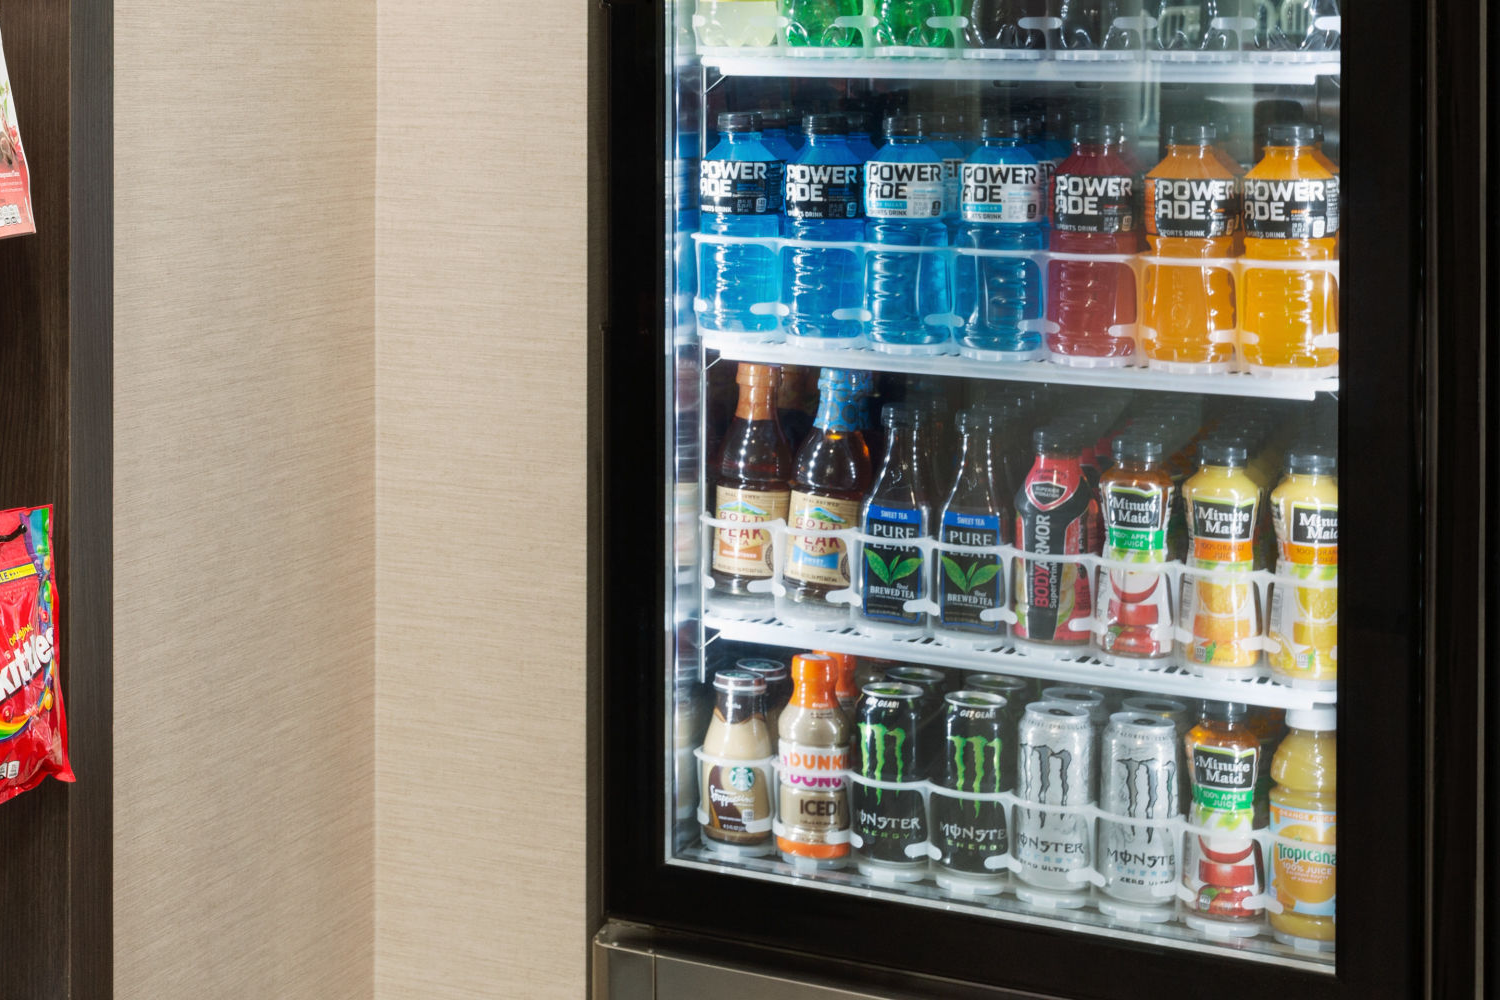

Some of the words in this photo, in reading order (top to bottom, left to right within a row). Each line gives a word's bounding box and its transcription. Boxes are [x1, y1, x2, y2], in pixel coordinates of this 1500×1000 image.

[701, 162, 766, 179] POWER
[786, 164, 857, 184] POWER
[869, 164, 942, 182] POWER
[963, 167, 1037, 185] POWER
[963, 185, 1001, 202] ADE
[1055, 176, 1133, 197] POWER
[1158, 180, 1235, 200] POWER
[1244, 180, 1324, 201] POWER
[1055, 197, 1098, 215] ADE
[1157, 201, 1208, 220] ADE
[1244, 202, 1287, 220] ADE
[1113, 497, 1156, 510] Minute
[881, 510, 896, 519] SWEET
[897, 511, 908, 519] TEA
[957, 516, 972, 525] SWEET
[973, 518, 985, 526] TEA
[1118, 510, 1150, 523] Maid
[1199, 507, 1249, 521] Minute
[873, 524, 915, 539] PURE
[1205, 520, 1244, 534] Maid
[950, 531, 992, 546] PURE
[870, 586, 898, 597] BREWED
[900, 589, 915, 599] TEA
[948, 593, 977, 604] BREWED
[980, 596, 993, 606] TEA
[9, 624, 33, 645] ORIGINAL
[1199, 758, 1250, 772] Minute
[1206, 771, 1245, 784] Maid
[800, 799, 837, 816] ICED
[1278, 844, 1335, 865] Tropicana
